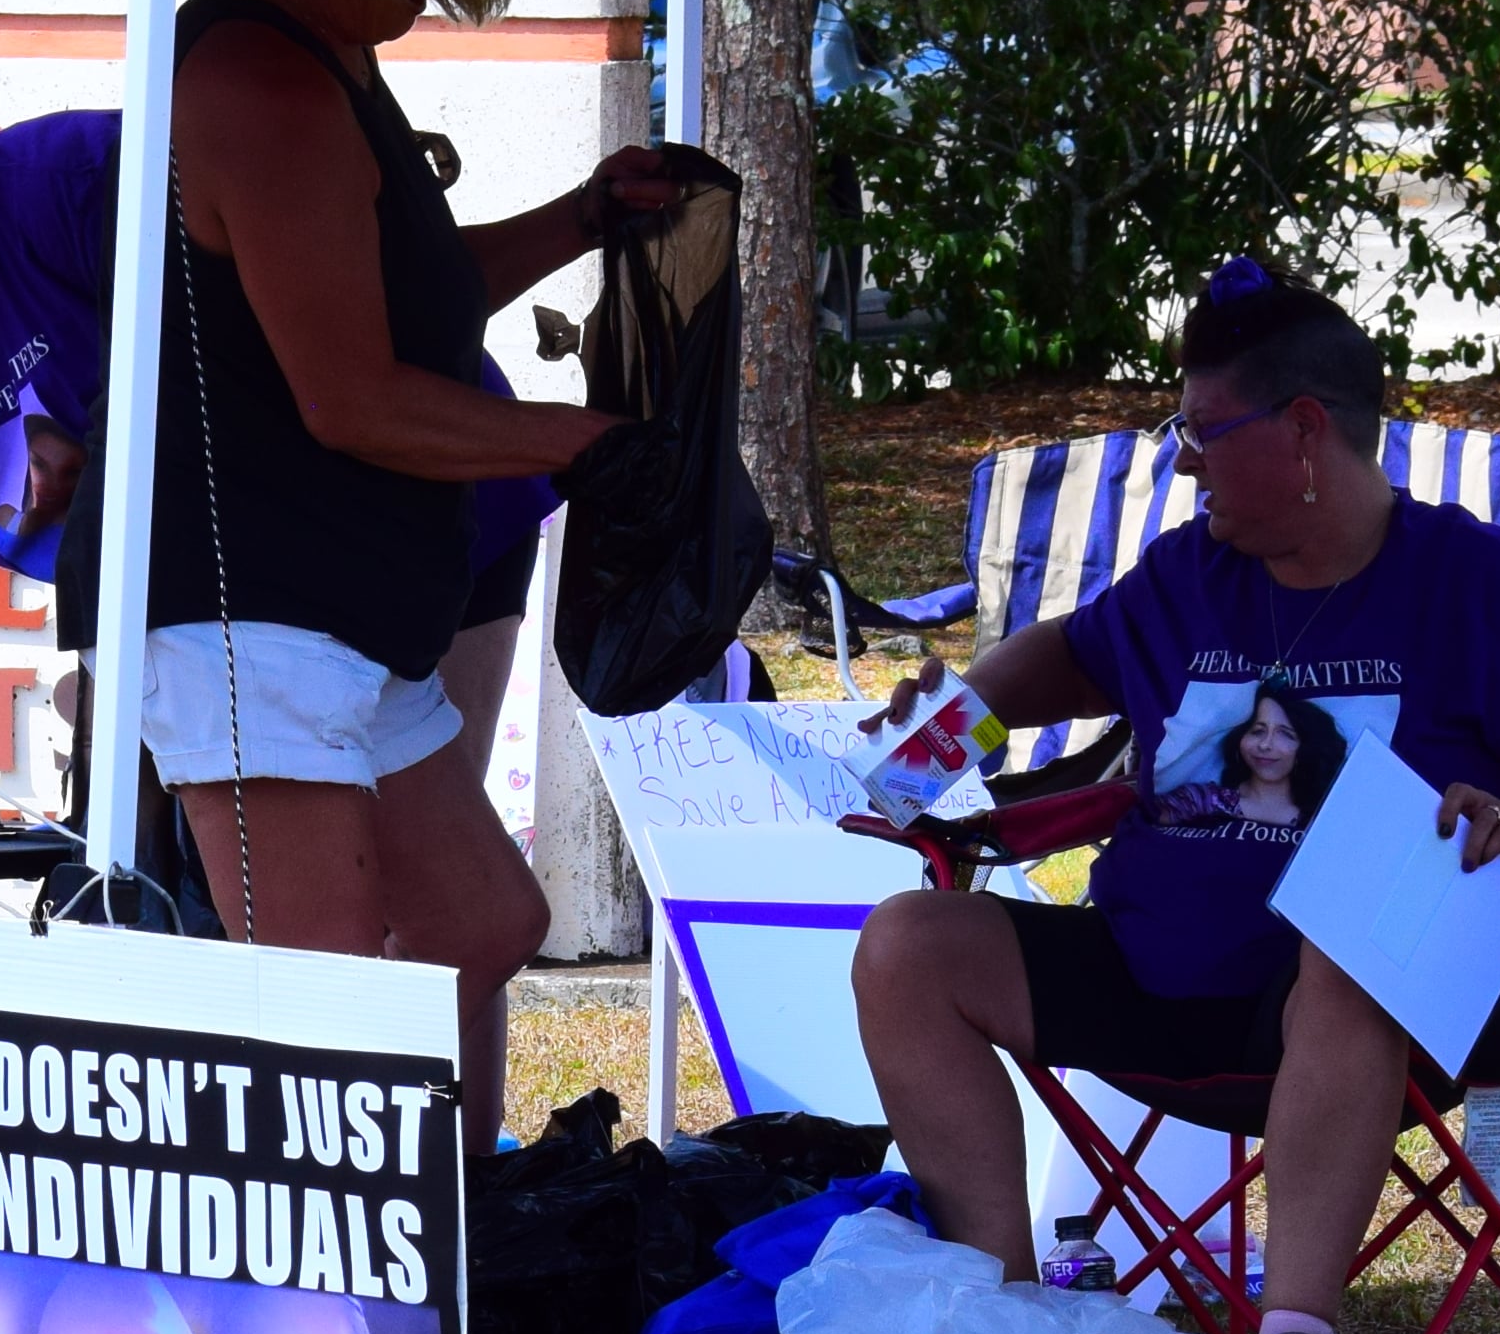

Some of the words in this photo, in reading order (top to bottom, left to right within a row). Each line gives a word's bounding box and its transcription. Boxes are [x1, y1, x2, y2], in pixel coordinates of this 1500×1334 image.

[1283, 658, 1403, 690] MATTERS
[612, 712, 735, 778] FREE
[924, 718, 958, 755] NARCAN
[638, 776, 758, 828] Save
[770, 773, 800, 827] A
[798, 762, 868, 820] Life
[1235, 820, 1306, 846] Poiso
[280, 1073, 432, 1176] JUST
[1042, 1262, 1074, 1278] WER
